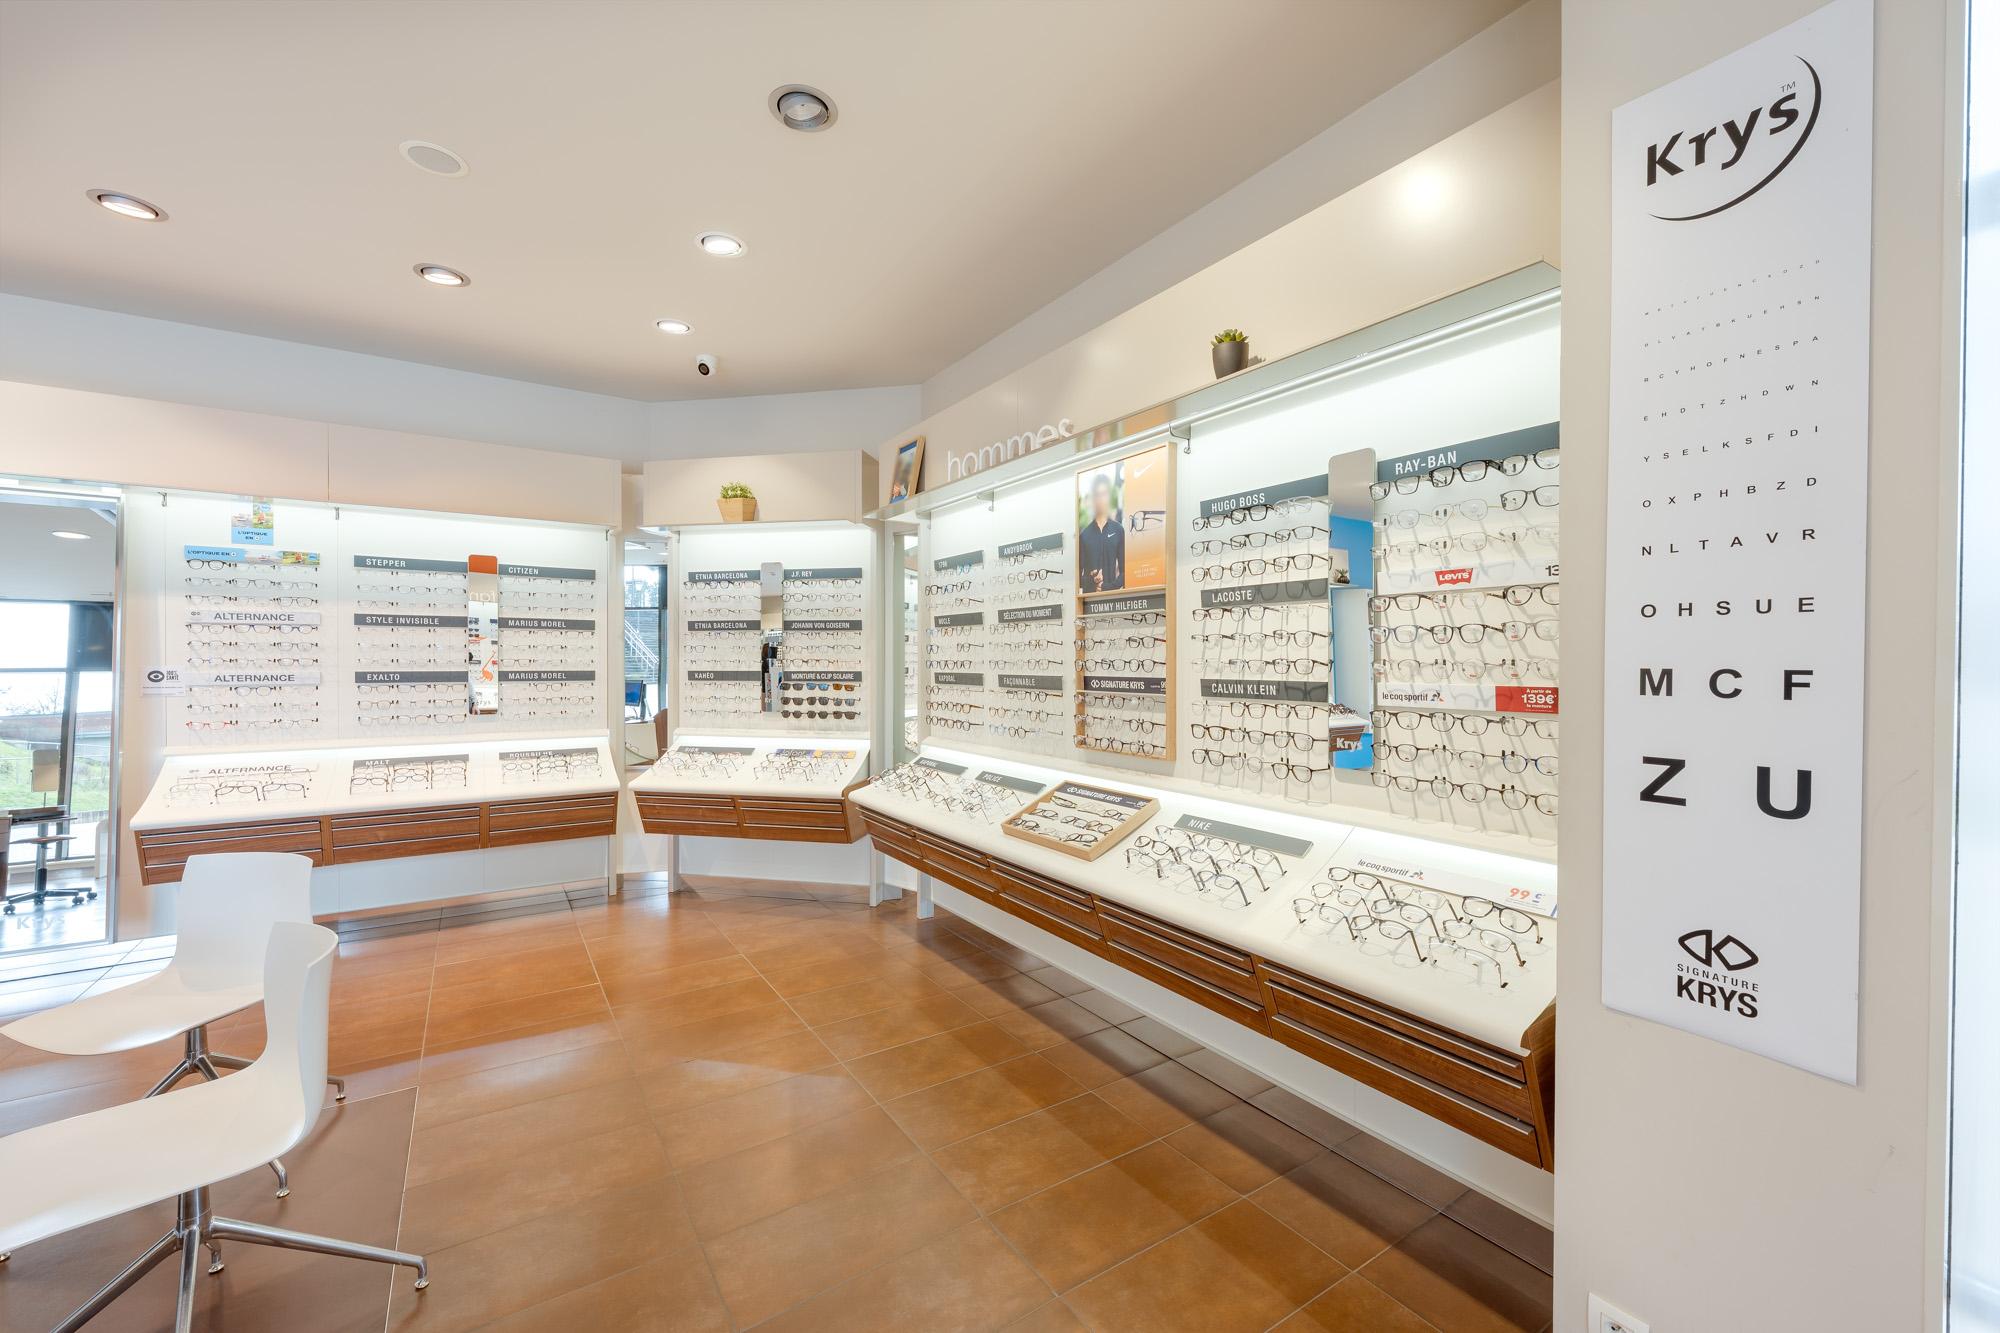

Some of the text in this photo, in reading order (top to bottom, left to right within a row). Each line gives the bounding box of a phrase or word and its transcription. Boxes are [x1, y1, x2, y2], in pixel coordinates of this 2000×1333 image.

[1646, 92, 1800, 187] Krys
[1643, 455, 1650, 463] Y
[1663, 452, 1670, 460] S
[1682, 448, 1689, 456] E
[1702, 445, 1709, 453] L
[1722, 440, 1731, 449] K
[1745, 436, 1753, 445] S
[1767, 432, 1775, 441] F
[1789, 429, 1799, 438] D
[1395, 450, 1458, 475] RAY-BAN
[1642, 477, 1817, 509] O X P H B Z D
[1211, 492, 1266, 513] HUGO BOSS
[1641, 528, 1816, 557] N L T A V R
[365, 558, 407, 568] STEPPER
[508, 566, 539, 575] CITIZEN
[695, 571, 748, 580] ETNIA BARCELONA
[1211, 590, 1253, 603] LACOSTE
[1090, 599, 1148, 613] TOMMY HILFIGER
[1640, 596, 1815, 619] O H S U E
[213, 612, 295, 622] ALTERNANCE
[365, 616, 440, 626] STYLE INVISIBLE
[508, 619, 567, 628] MARIUS MOREL
[713, 621, 748, 629] BARCELONA
[213, 673, 296, 683] ALTERNANCE
[366, 673, 400, 681] EXALTO
[508, 671, 567, 680] MARIUS MOREL
[1100, 680, 1130, 688] SIGNATURE
[1130, 681, 1145, 690] KRYS
[1211, 682, 1277, 697] CALVIN KLEIN
[1639, 667, 1814, 701] M C F
[1382, 692, 1428, 702] le coq sportif
[1336, 737, 1363, 752] Krys
[208, 764, 292, 774] ALTERNANCE
[1639, 755, 1813, 821] Z U
[1076, 788, 1123, 803] SIGNATURE KRYS
[1187, 818, 1213, 832] NIKE
[1366, 862, 1382, 871] coq
[1381, 865, 1409, 877] sportif
[1509, 887, 1531, 900] 99
[1676, 962, 1760, 993] SIGNATURE
[1676, 974, 1760, 1019] KRYS
